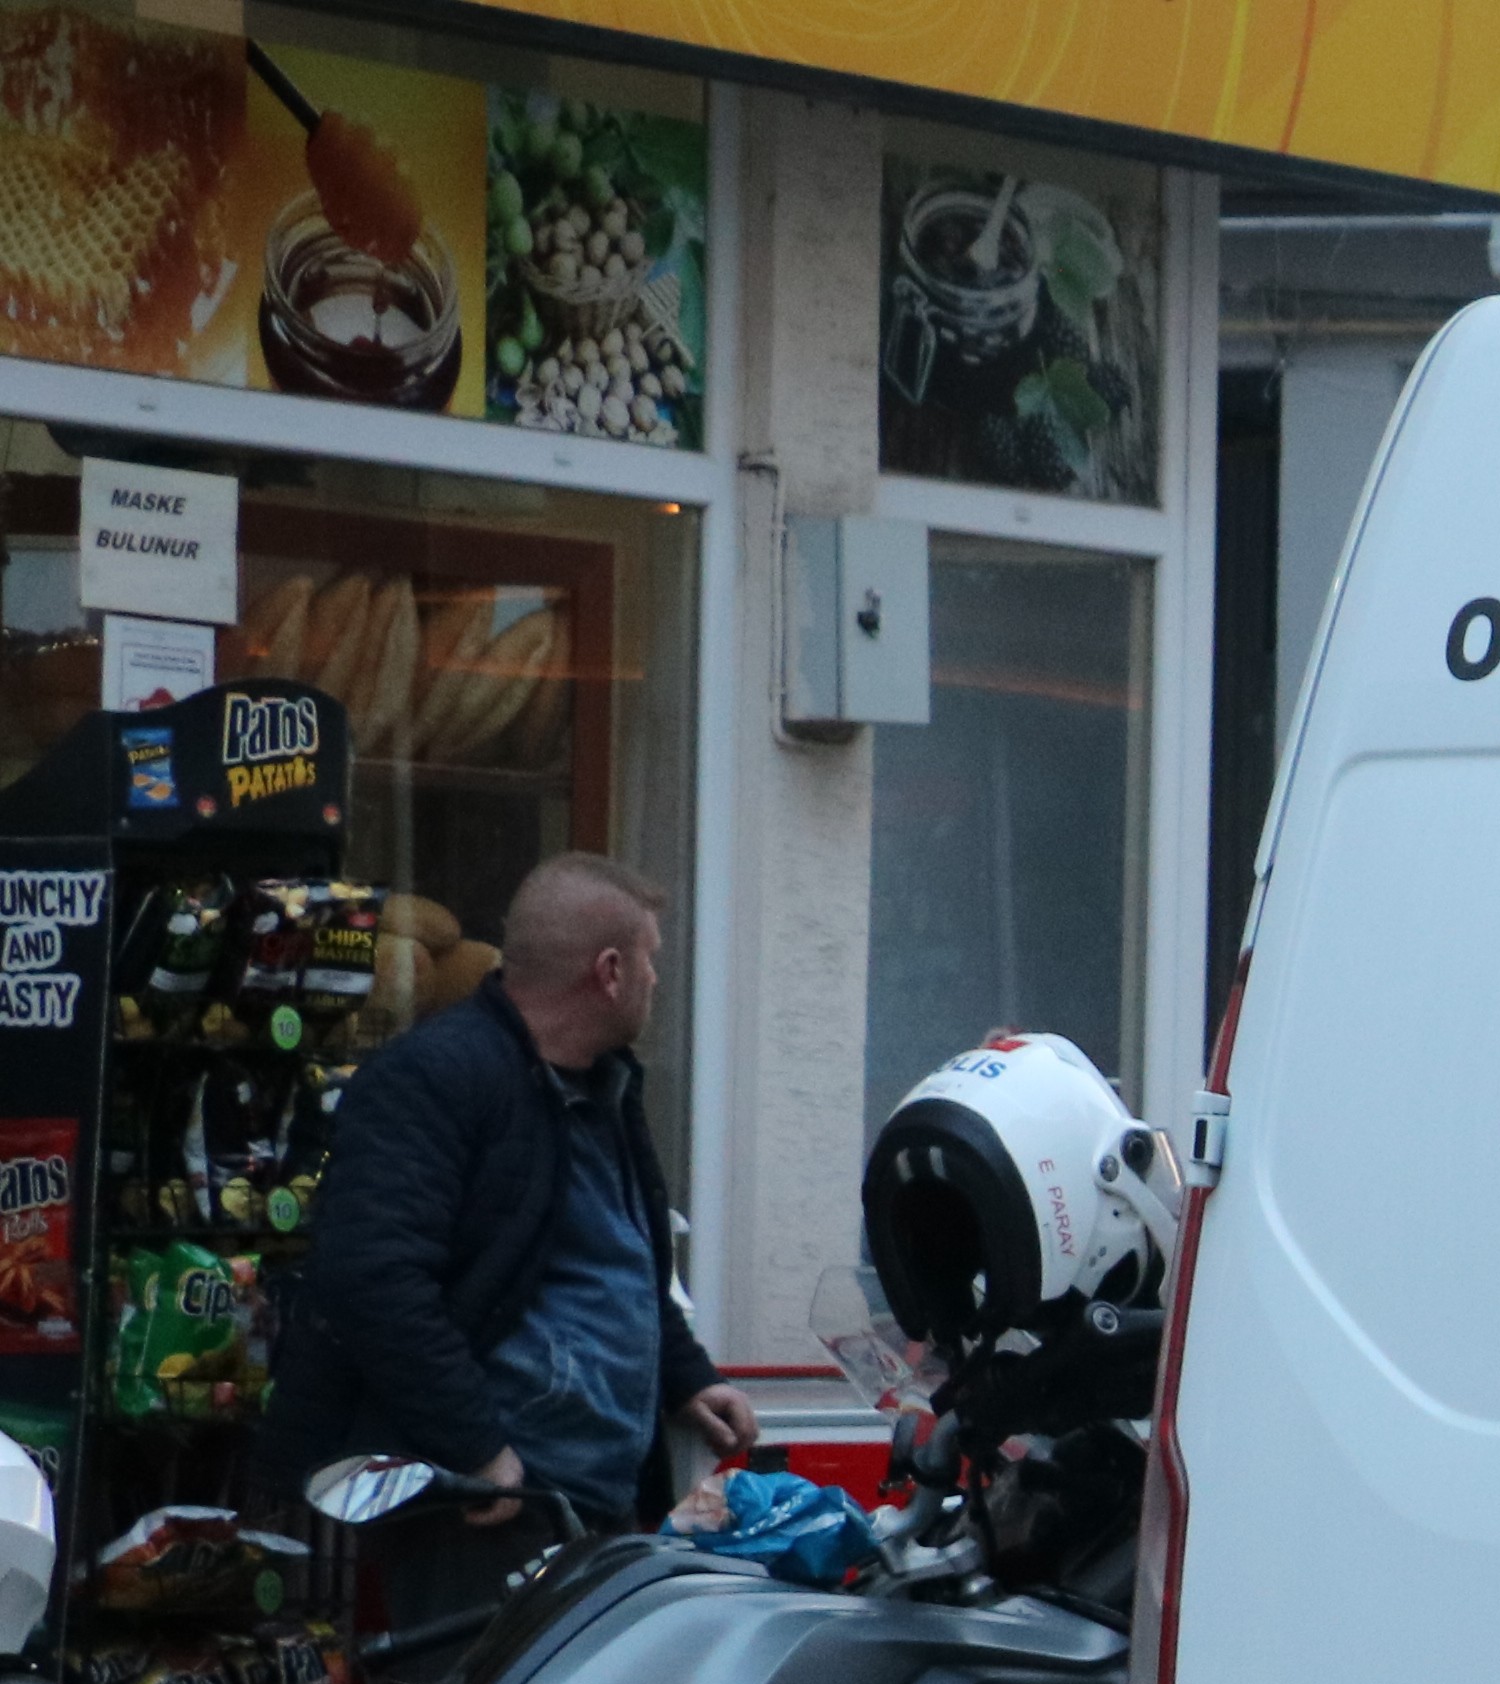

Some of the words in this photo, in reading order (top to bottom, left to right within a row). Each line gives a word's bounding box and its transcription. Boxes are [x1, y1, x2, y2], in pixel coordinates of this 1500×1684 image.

[110, 488, 187, 516] MASKE
[95, 528, 200, 560] BULUNUR
[226, 755, 317, 808] PATATOS
[7, 929, 57, 965] AND
[314, 927, 374, 949] CHIPS
[277, 1020, 295, 1036] 10
[273, 1203, 292, 1220] 10
